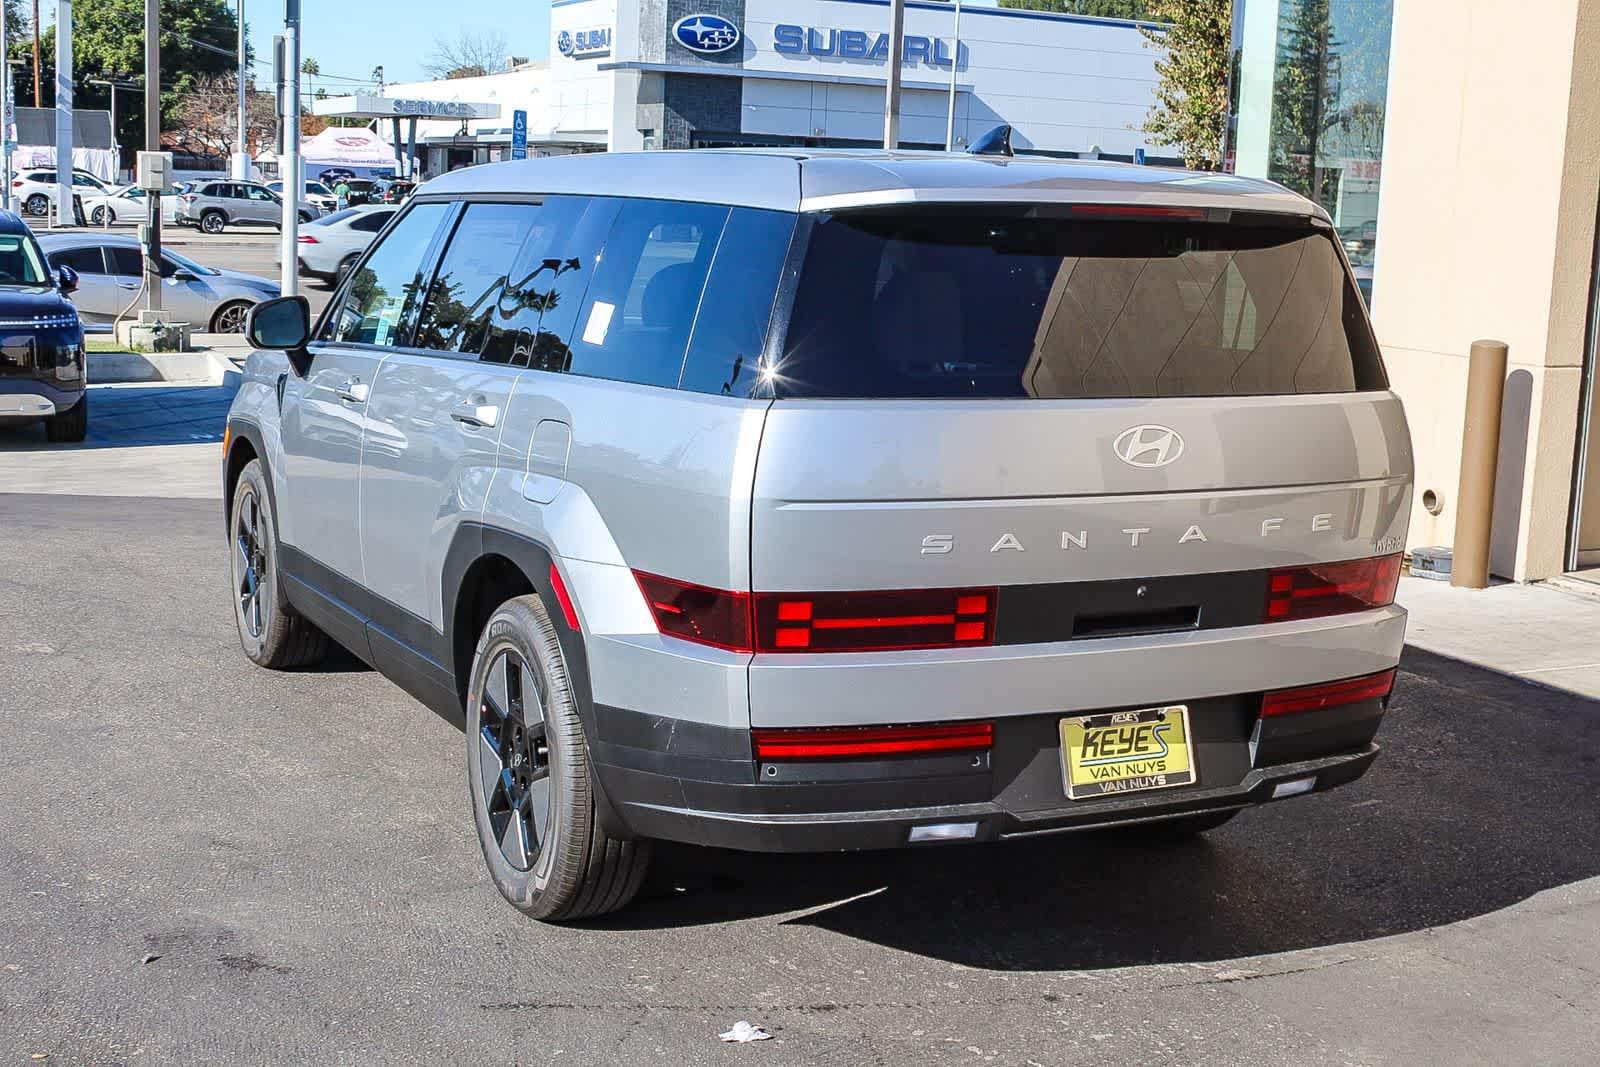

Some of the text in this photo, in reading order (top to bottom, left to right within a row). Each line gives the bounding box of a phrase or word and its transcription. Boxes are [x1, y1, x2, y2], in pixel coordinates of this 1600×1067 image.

[774, 24, 965, 66] SUBARU
[393, 98, 472, 116] SERVICE
[920, 513, 1332, 555] SANTA FE
[1080, 723, 1171, 766] KEYES
[1090, 760, 1166, 779] VAN NUYS
[1100, 775, 1167, 793] VAN NUYS
